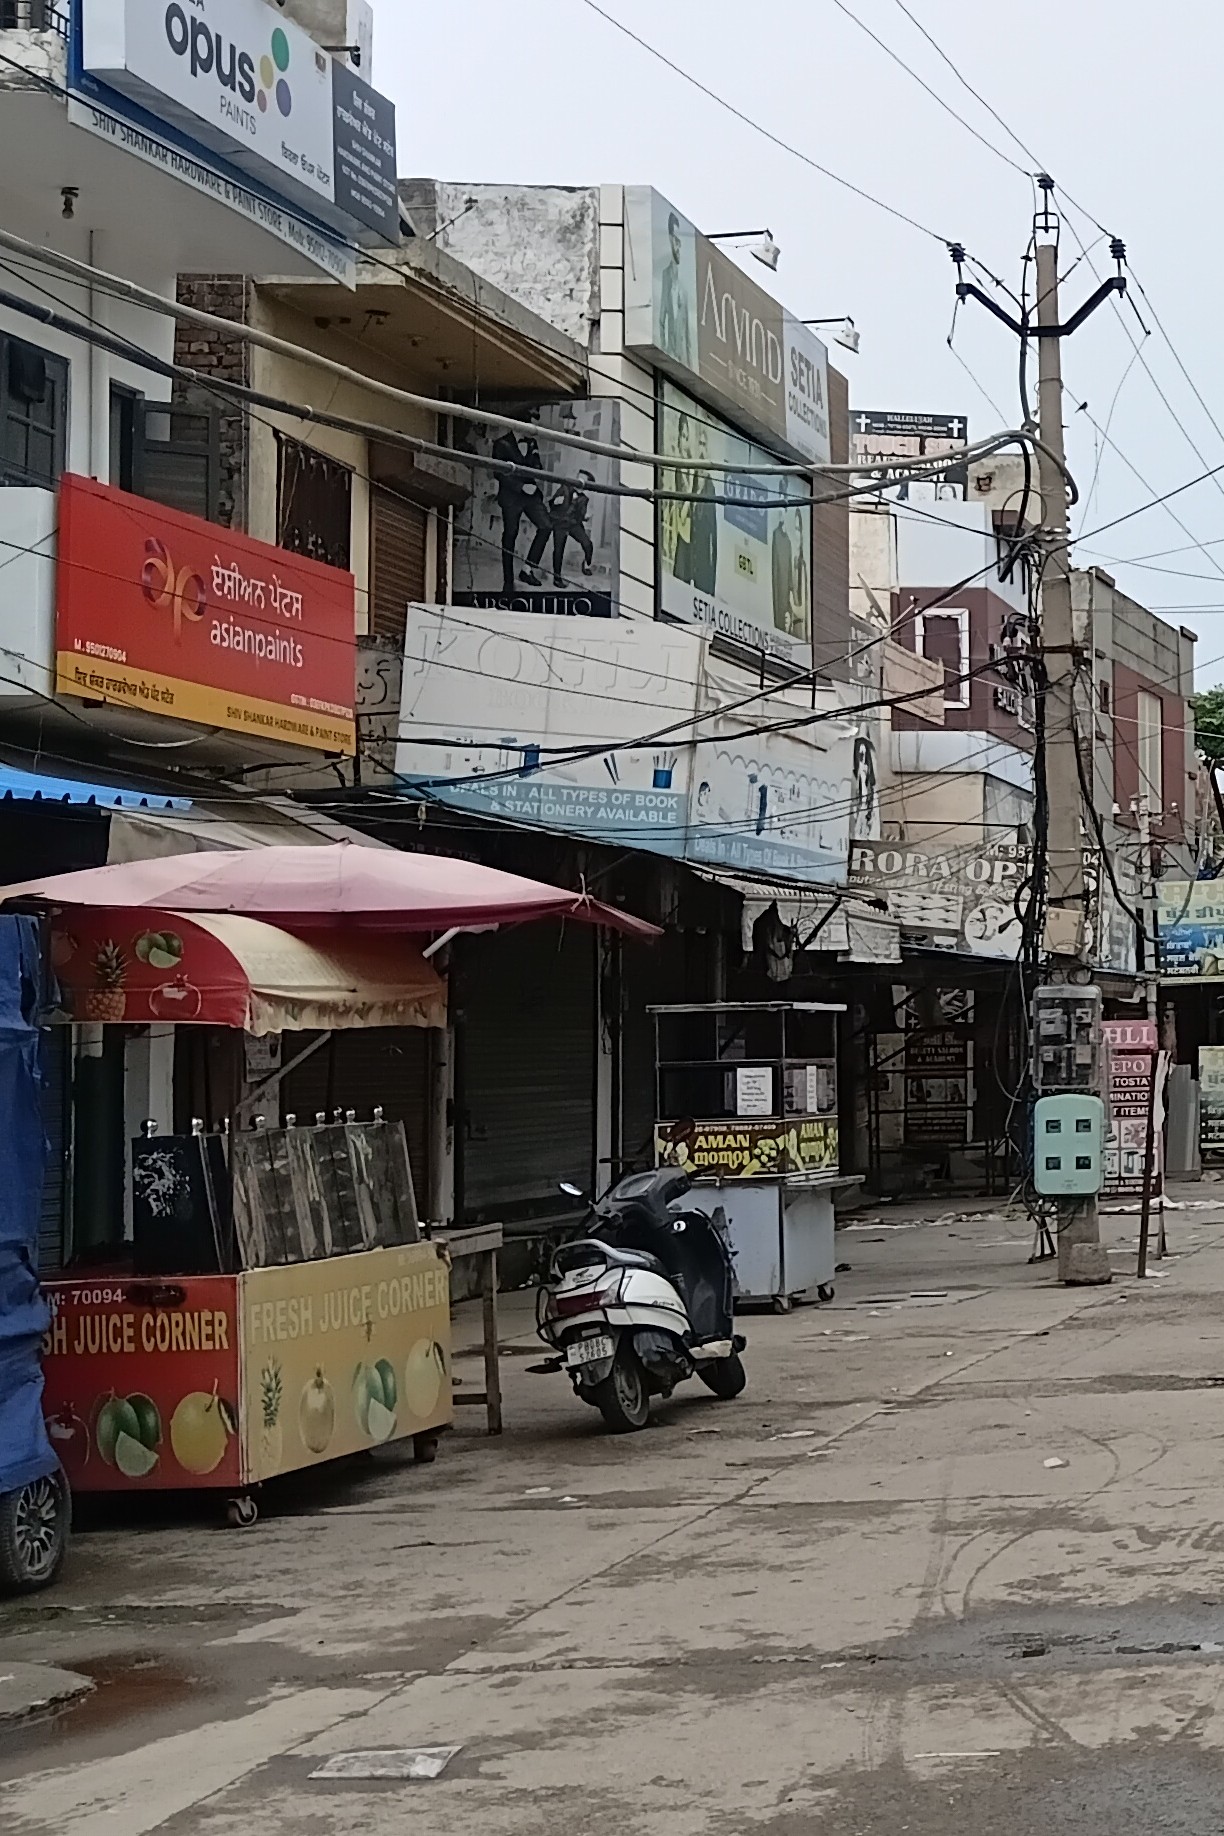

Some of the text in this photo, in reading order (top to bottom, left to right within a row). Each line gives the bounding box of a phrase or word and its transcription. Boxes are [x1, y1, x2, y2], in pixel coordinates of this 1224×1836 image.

[165, 2, 256, 104] opus
[219, 95, 257, 135] PAINTS
[92, 110, 117, 136] SHIV
[120, 126, 168, 164] SHANKAR
[170, 152, 222, 196] HARDWARE
[232, 184, 256, 215] PAINT
[258, 203, 282, 232] STORE
[789, 346, 825, 411] SETIA
[788, 391, 828, 440] COLLECTIONS
[692, 596, 717, 629] SETIA
[718, 609, 769, 652] COLLECTIONS
[211, 615, 303, 671] asianpaints
[227, 706, 241, 719] SHIV
[244, 710, 273, 727] SHANKAR
[275, 716, 309, 736] HARDWARE
[316, 726, 332, 740] PAINT
[503, 785, 517, 797] IN
[529, 787, 556, 800] ALL
[561, 789, 607, 804] TYPES
[612, 792, 630, 805] OF
[635, 795, 678, 809] BOOK
[504, 800, 595, 819] STATIONERY
[597, 806, 677, 824] AVAILABLE
[850, 848, 951, 878] RORA
[1104, 1026, 1155, 1044] HLI
[1111, 1060, 1145, 1073] EPO
[1115, 1077, 1149, 1087] TOSTA
[694, 1135, 749, 1149] AMAN
[694, 1151, 749, 1169] momos
[250, 1267, 447, 1346] FRESH JUICE CORNER
[74, 1312, 134, 1355] JUICE
[141, 1310, 230, 1353] CORNER
